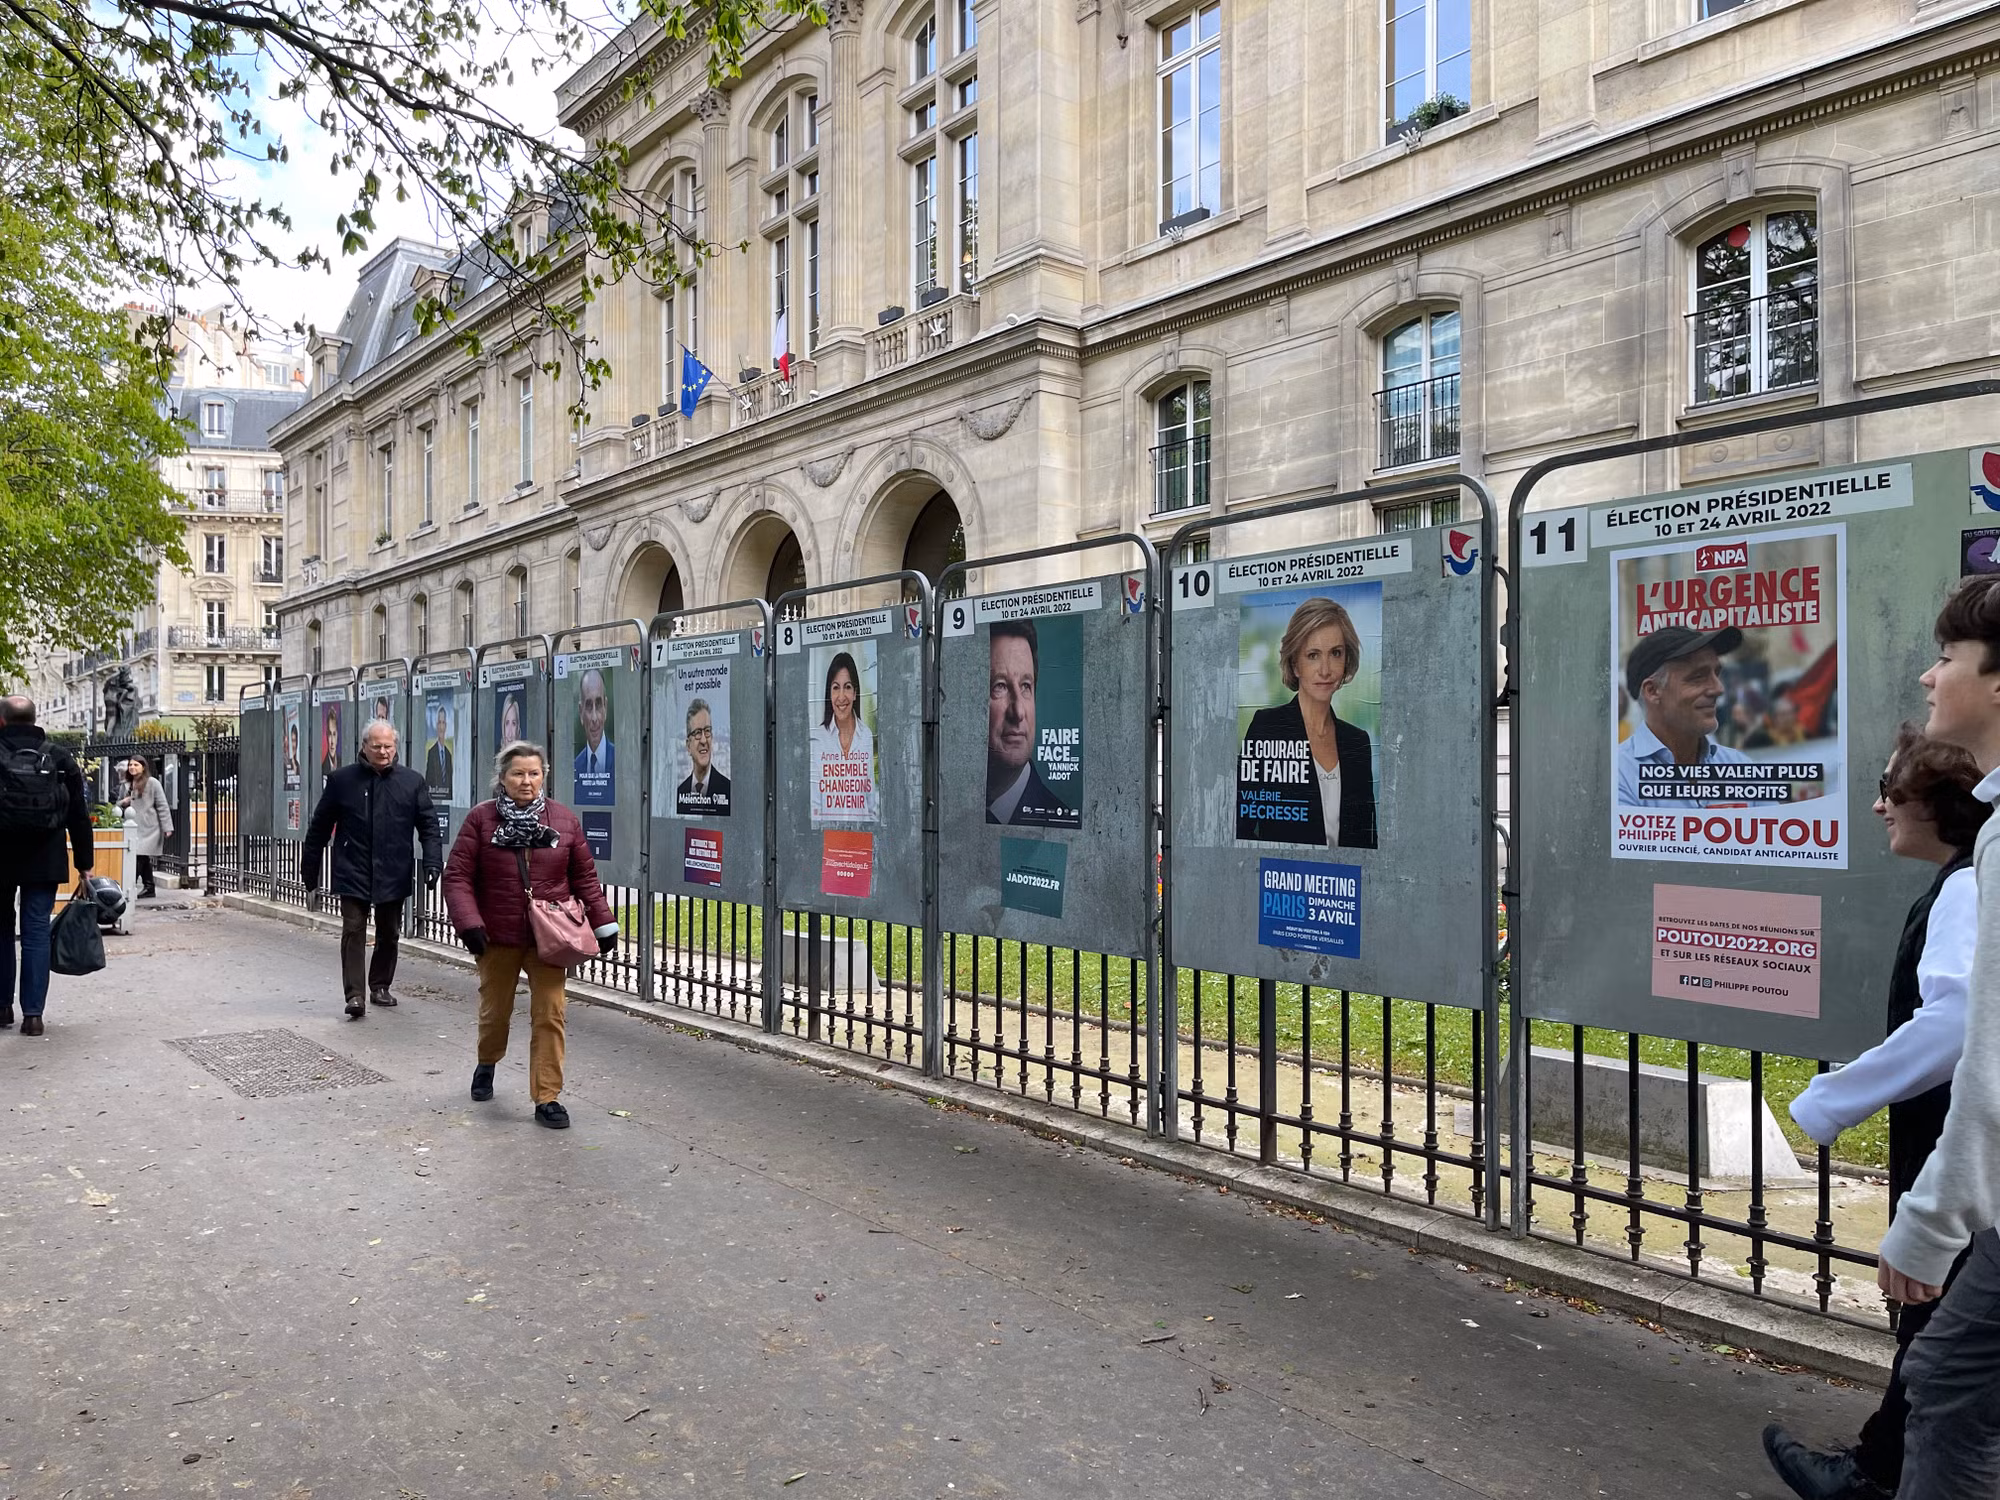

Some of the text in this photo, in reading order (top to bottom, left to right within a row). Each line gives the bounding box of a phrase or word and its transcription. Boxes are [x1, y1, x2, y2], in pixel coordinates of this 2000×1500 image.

[1607, 472, 1891, 528] ÉLECTION PRÉSIDENTIELLE
[1654, 501, 1831, 537] 10 ET 24 AVRIL 2022
[1530, 517, 1576, 555] 11
[1229, 545, 1399, 578] ÉLECTION PRÉSIDENTIELLE
[1714, 548, 1746, 565] NPA
[1179, 570, 1210, 598] 10
[1258, 565, 1364, 587] 10 ET 24 AVRIL 2022
[1637, 566, 1820, 612] L'URGENCE
[981, 587, 1094, 611] ÉLECTION PRÉSIDENTIELLE
[952, 607, 965, 630] 9
[1002, 602, 1071, 619] 10 ET 24 AVRIL 2022
[1639, 600, 1818, 635] ANTICAPITALISTE
[806, 614, 887, 634] ÉLECTION PRÉSIDENTIELLE
[844, 629, 859, 638] AVRIL
[860, 627, 872, 636] 2022
[784, 627, 793, 645] 8
[656, 644, 663, 661] 7
[558, 660, 564, 676] 6
[678, 664, 728, 680] Un autre monde
[482, 670, 487, 684] 5
[684, 677, 721, 693] est possible
[360, 684, 365, 697] 3
[1041, 728, 1080, 745] FAIRE
[821, 749, 869, 763] Anne Hidalgo
[1037, 746, 1070, 762] FACE
[1241, 740, 1310, 760] LE COURAGE
[822, 763, 868, 777] ENSEMBLE
[1048, 762, 1079, 772] YANNICK
[1240, 759, 1310, 784] DE FAIRE
[1641, 765, 1818, 779] NOS VIES VALENT PLUS
[1048, 772, 1071, 780] JADOT
[819, 779, 872, 793] CHANGEONS
[1641, 784, 1788, 799] QUE LEURS PROFITS
[826, 795, 865, 808] D'AVENIR
[1241, 788, 1281, 802] VALÉRIE
[1240, 801, 1309, 822] PÉCRESSE
[1618, 815, 1676, 829] VOTEZ
[1618, 829, 1677, 841] PHILIPPE
[1683, 816, 1839, 848] POUTOU
[1618, 843, 1839, 861] OUVRIER LICENCIÉ, CANDIDAT ANTICAPITALISTE
[1006, 872, 1060, 891] JADOT2022.FR
[1264, 870, 1356, 898] GRAND MEETING
[1263, 891, 1305, 919] PARIS
[1308, 896, 1356, 911] DIMANCHE
[1308, 908, 1356, 926] 3 AVRIL
[1658, 916, 1695, 925] RETROUVEZ
[1697, 919, 1708, 927] LES
[1709, 920, 1730, 929] DATES
[1742, 924, 1758, 932] NOS
[1760, 924, 1798, 935] RÉUNIONS
[1800, 929, 1815, 937] SUR
[1657, 928, 1816, 957] POUTOU2022.ORG
[1660, 949, 1812, 974] ET SUR LES RÉSEAUX SOCIAUX
[1714, 980, 1789, 997] PHILIPPE POUTOU
